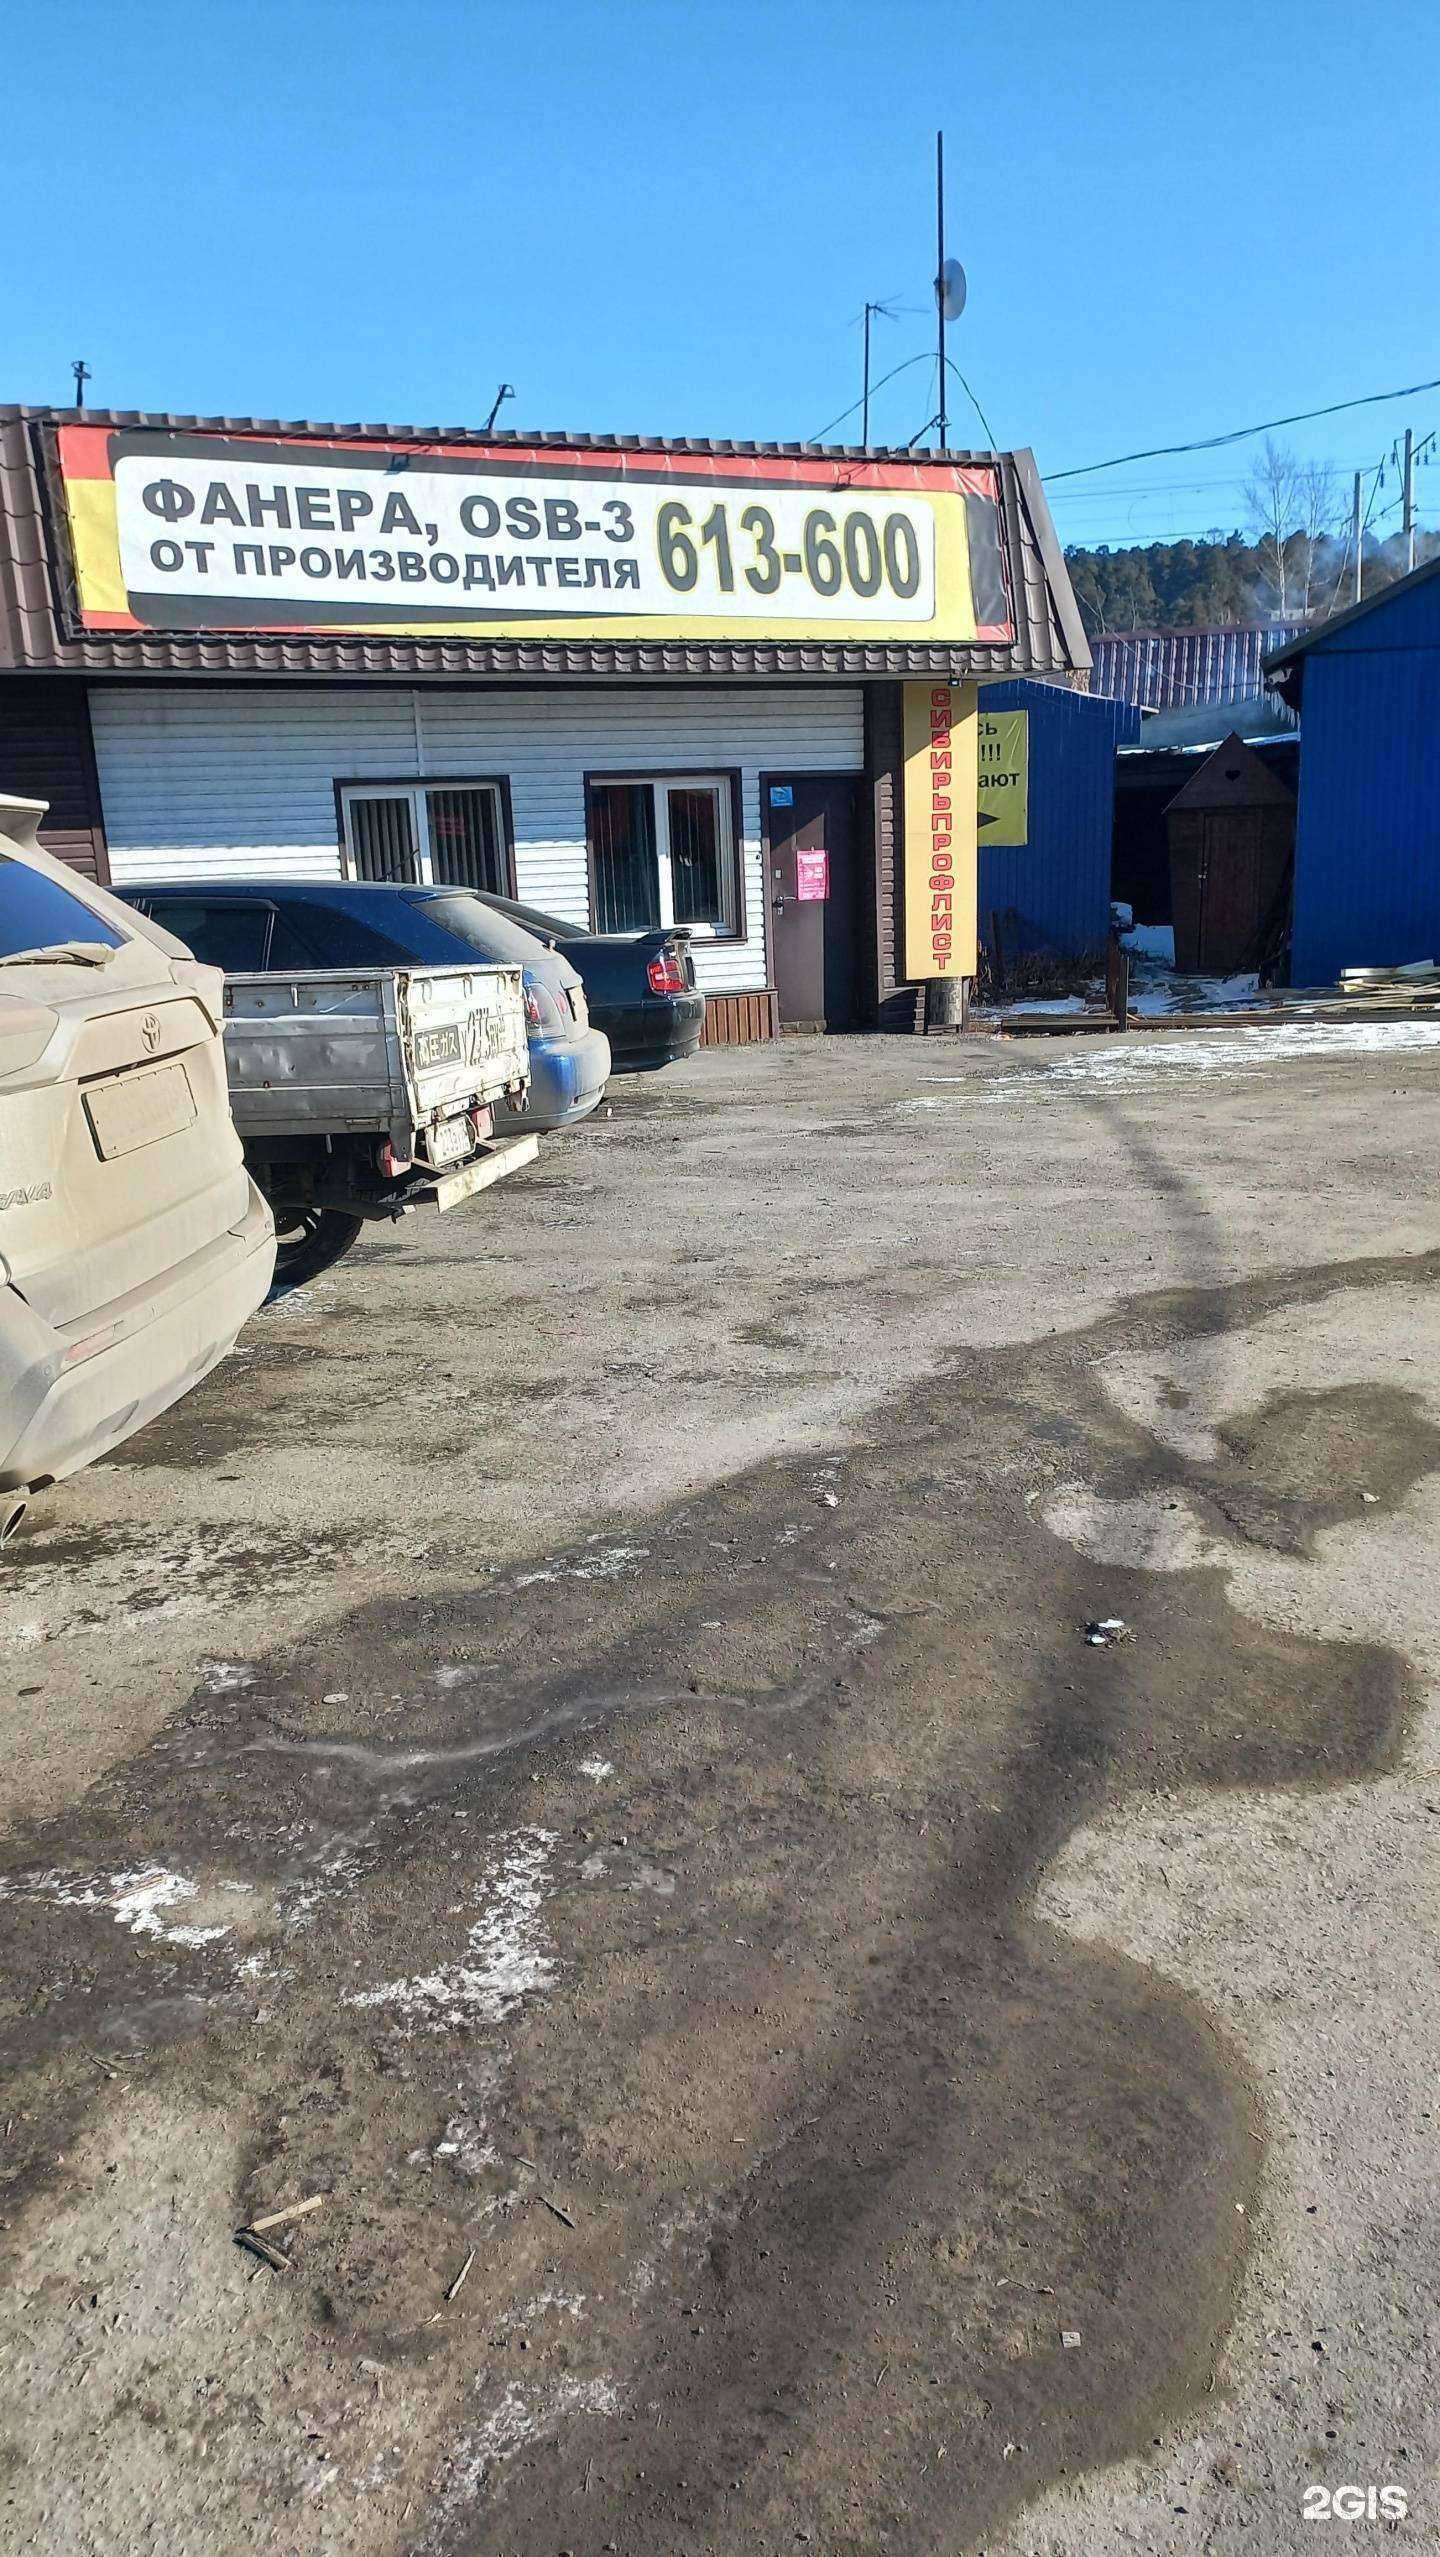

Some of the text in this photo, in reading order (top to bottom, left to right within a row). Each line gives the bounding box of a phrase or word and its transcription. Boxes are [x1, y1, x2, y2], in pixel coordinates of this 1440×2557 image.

[142, 478, 635, 547] ФАНЕРА, OSB-3
[657, 501, 920, 599] 613-600
[149, 539, 640, 592] ОТ ПРОИЗВОДИТЕЛЯ
[929, 688, 954, 970] СИБИРЬПРОФЛИСТ
